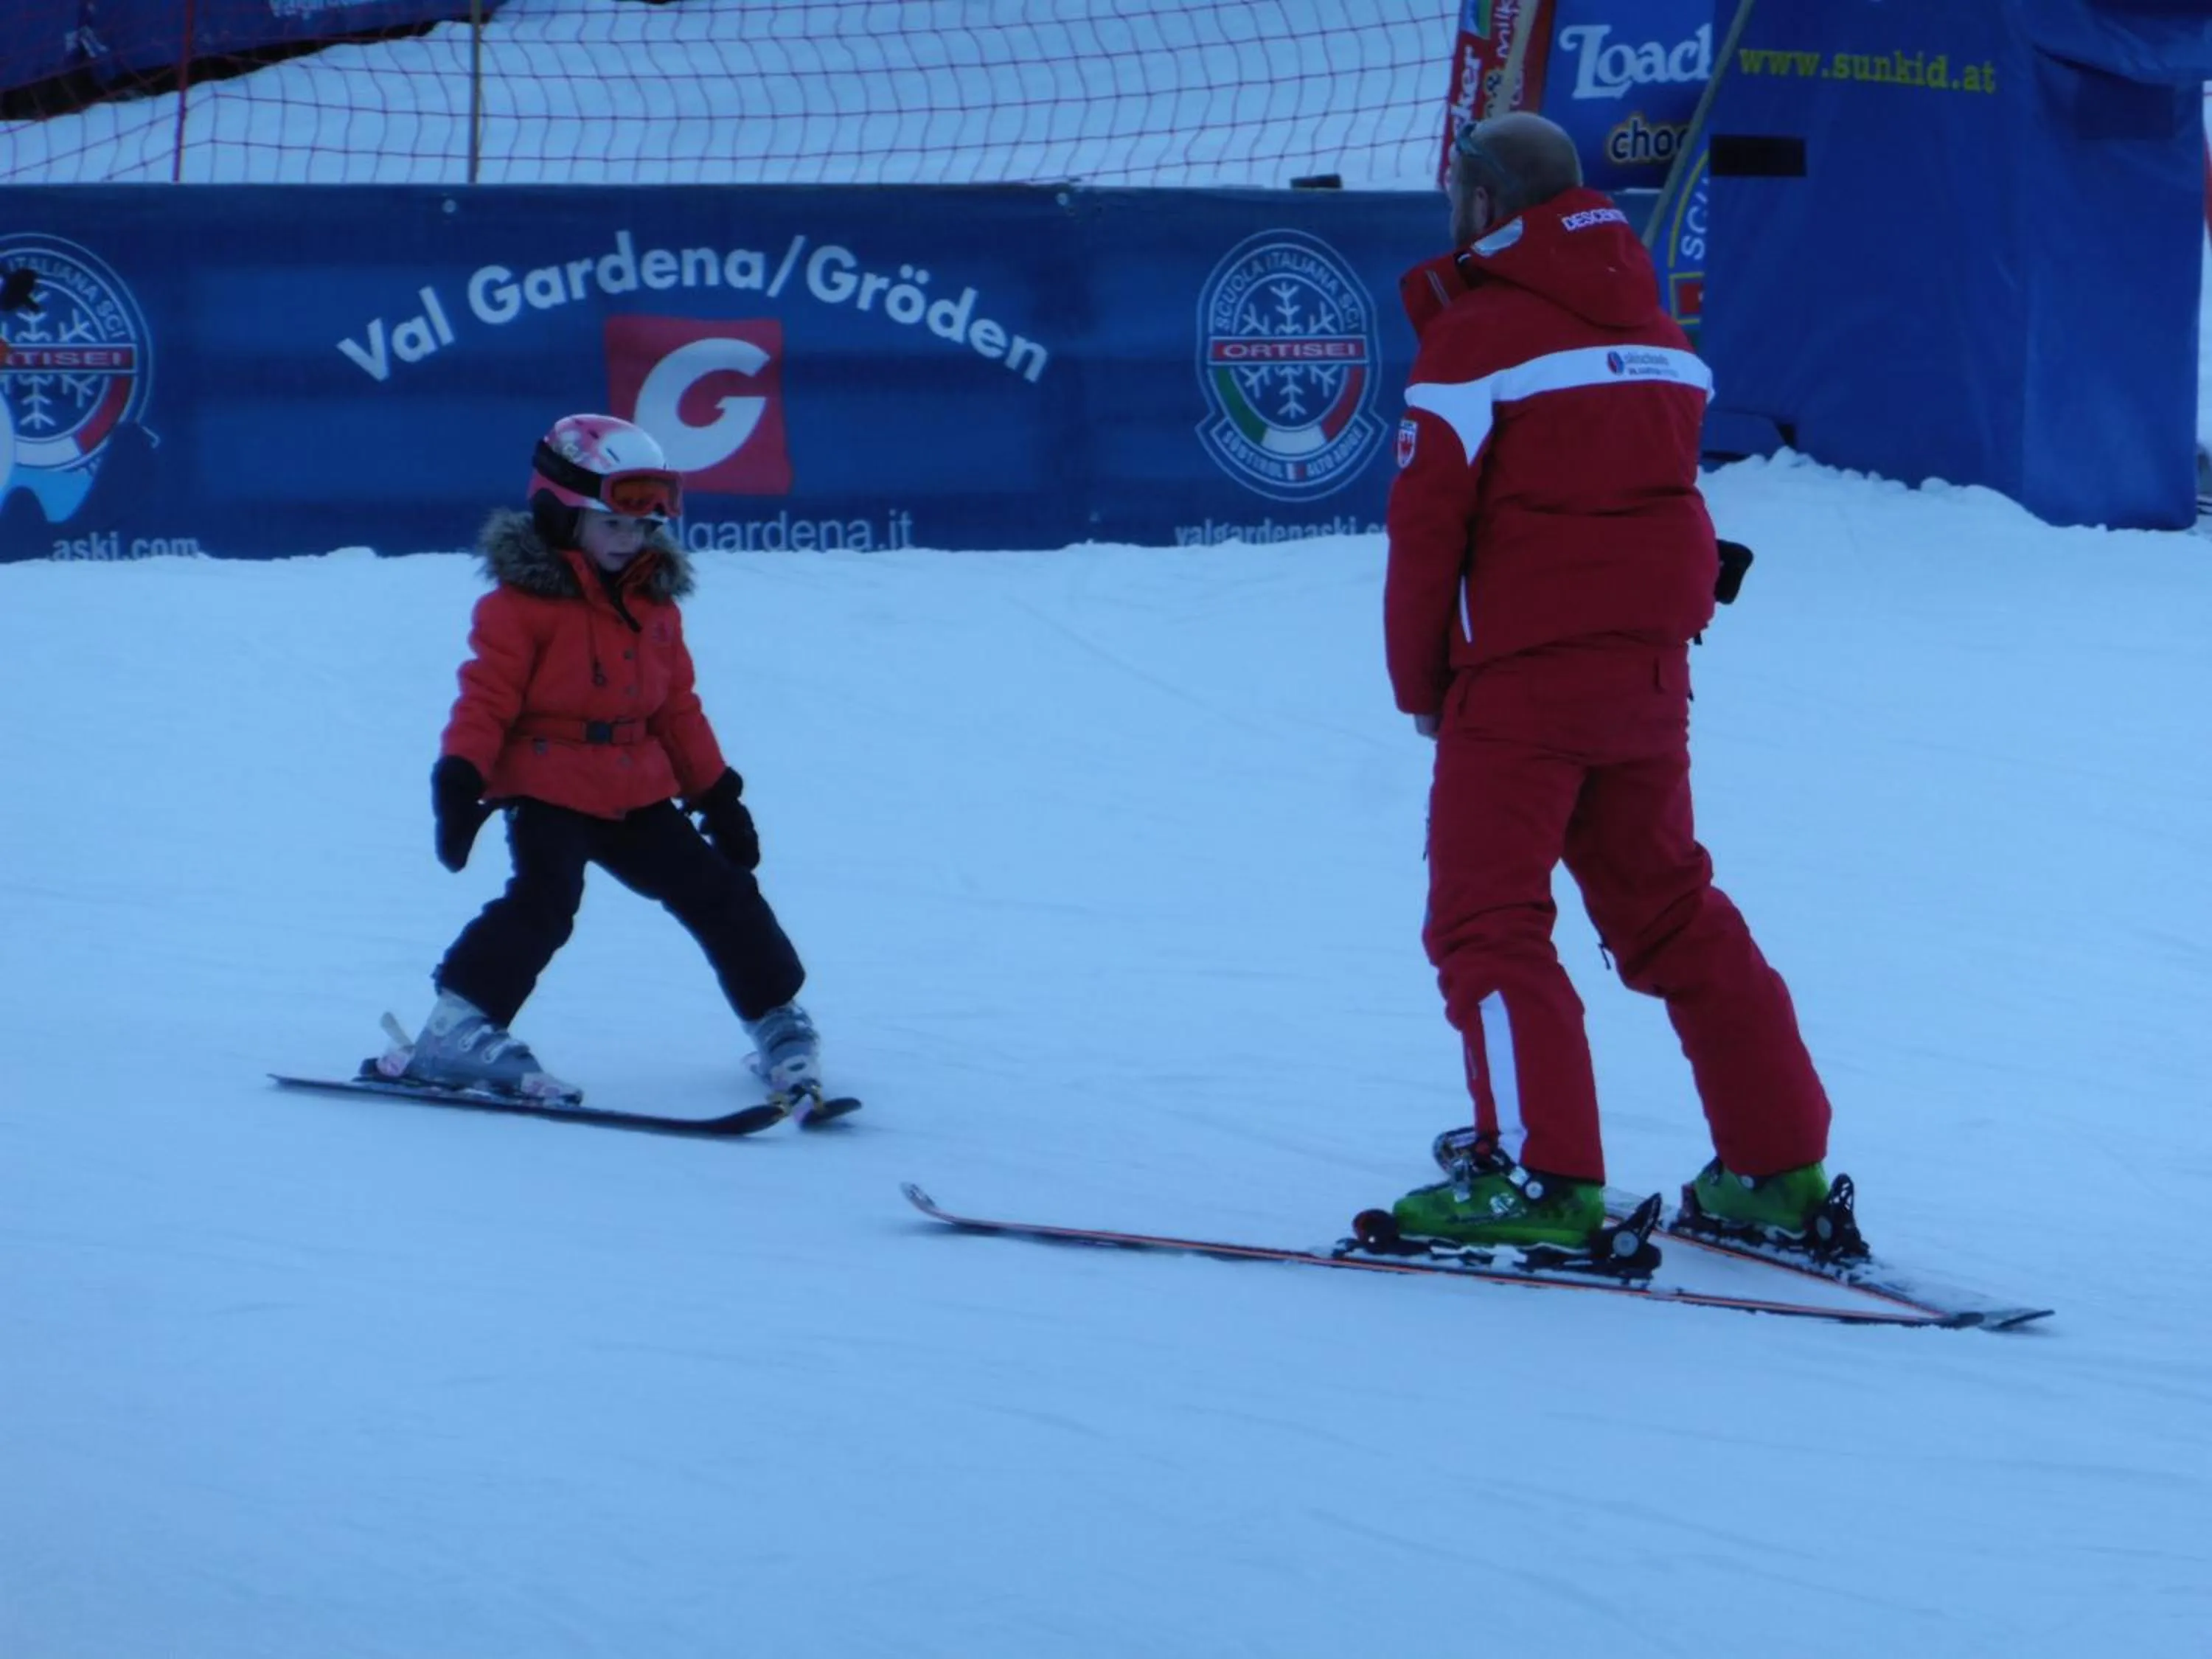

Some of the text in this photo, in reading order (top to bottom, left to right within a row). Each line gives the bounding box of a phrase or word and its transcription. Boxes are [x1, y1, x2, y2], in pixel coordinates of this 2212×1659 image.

[1739, 48, 1997, 94] www.sunkid.at
[1216, 251, 1360, 330] SCUOLA ITALIANA SCI
[336, 285, 455, 382] Val
[1222, 342, 1357, 358] ORTISEI
[6, 351, 120, 366] TISEI
